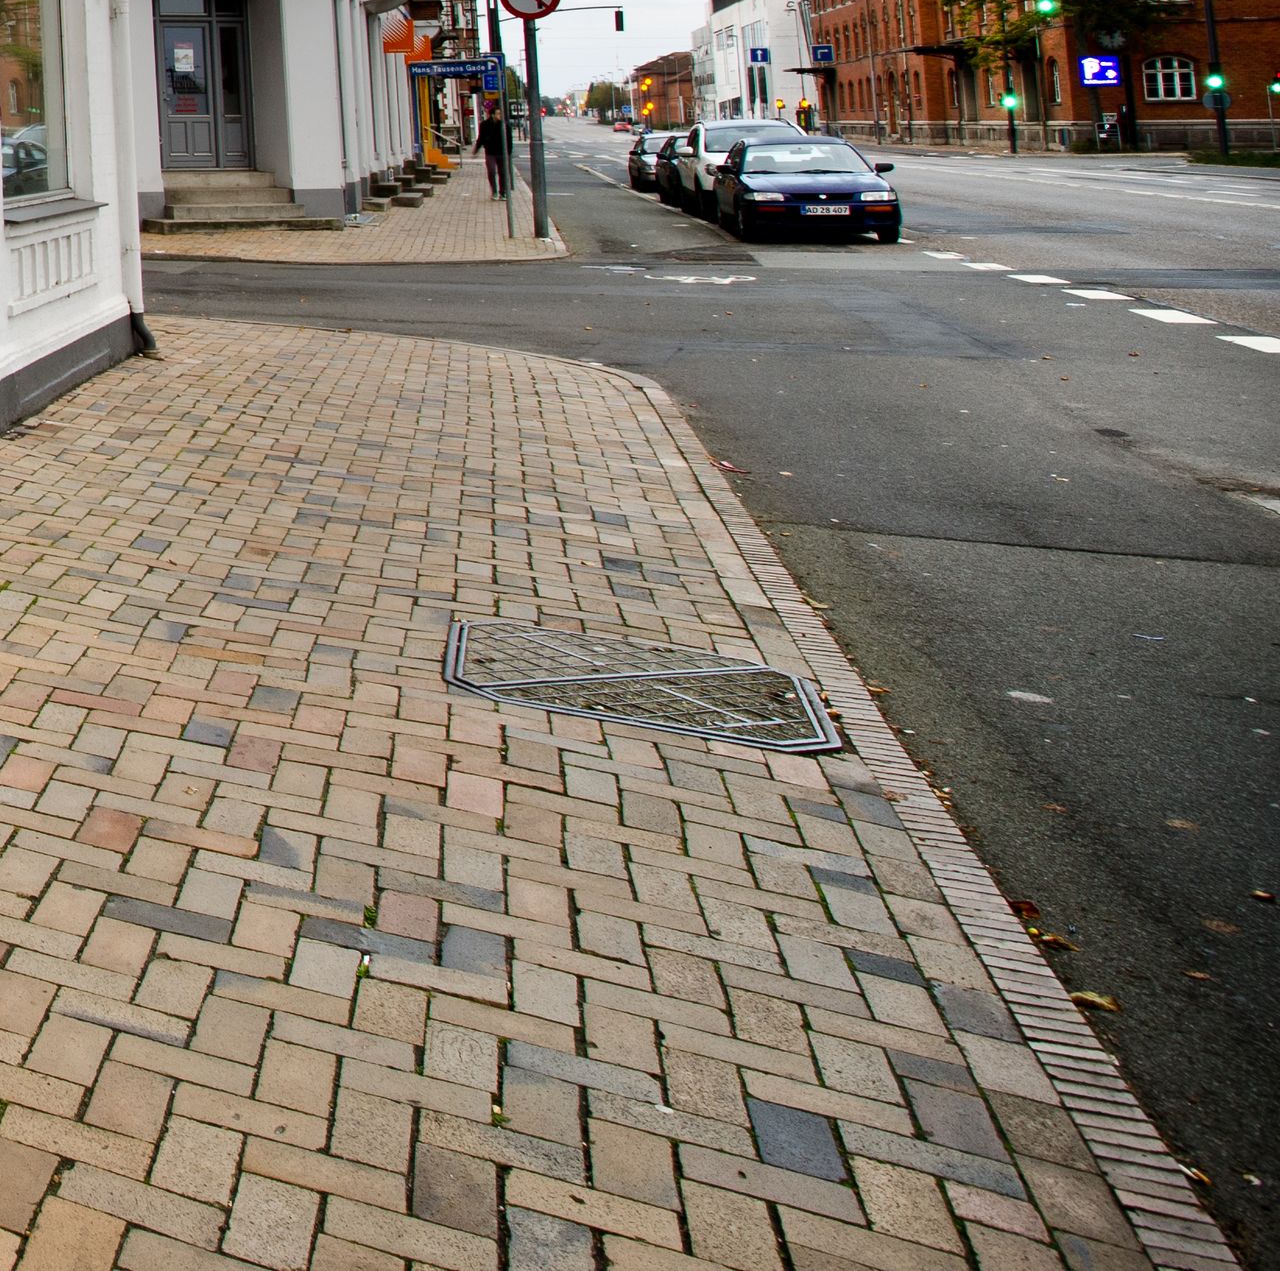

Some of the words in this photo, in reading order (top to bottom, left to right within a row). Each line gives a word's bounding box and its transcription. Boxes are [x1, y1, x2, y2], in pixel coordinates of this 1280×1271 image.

[411, 66, 431, 74] Hans
[433, 65, 464, 73] Tausens
[465, 63, 486, 72] Gade
